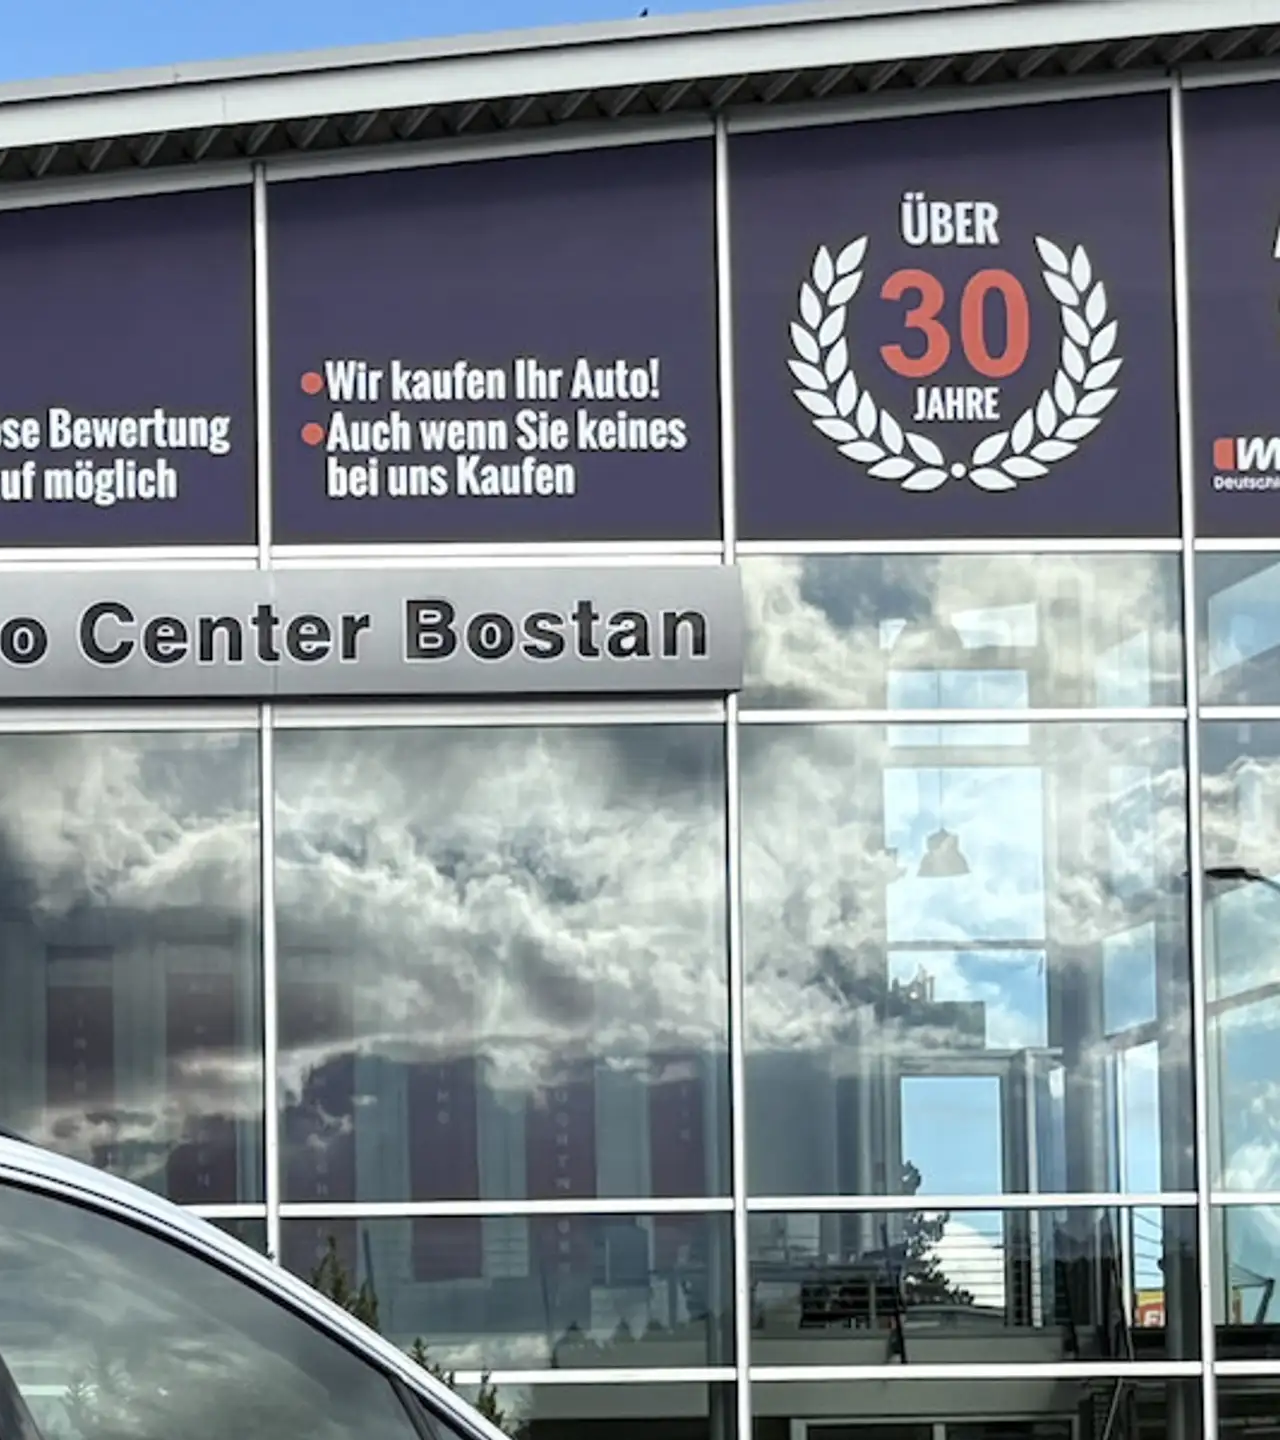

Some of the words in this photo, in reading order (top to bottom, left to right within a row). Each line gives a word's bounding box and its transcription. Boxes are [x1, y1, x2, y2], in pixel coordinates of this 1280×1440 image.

[902, 191, 1000, 245] ÜBER
[881, 269, 1030, 378] 30
[325, 360, 384, 401] Wir
[391, 359, 506, 401] kaufen
[515, 358, 564, 400] Ihr
[570, 357, 660, 400] Auto!
[913, 386, 1001, 421] JAHRE
[49, 407, 231, 455] Bewertung
[326, 410, 412, 452] Auch
[419, 419, 508, 451] wenn
[515, 408, 569, 451] Sie
[577, 408, 688, 450] keines
[44, 457, 177, 506] möglich
[327, 456, 379, 498] bei
[387, 464, 449, 497] uns
[456, 454, 575, 496] Kaufen
[78, 598, 373, 670] Center
[403, 597, 710, 664] Bostan
